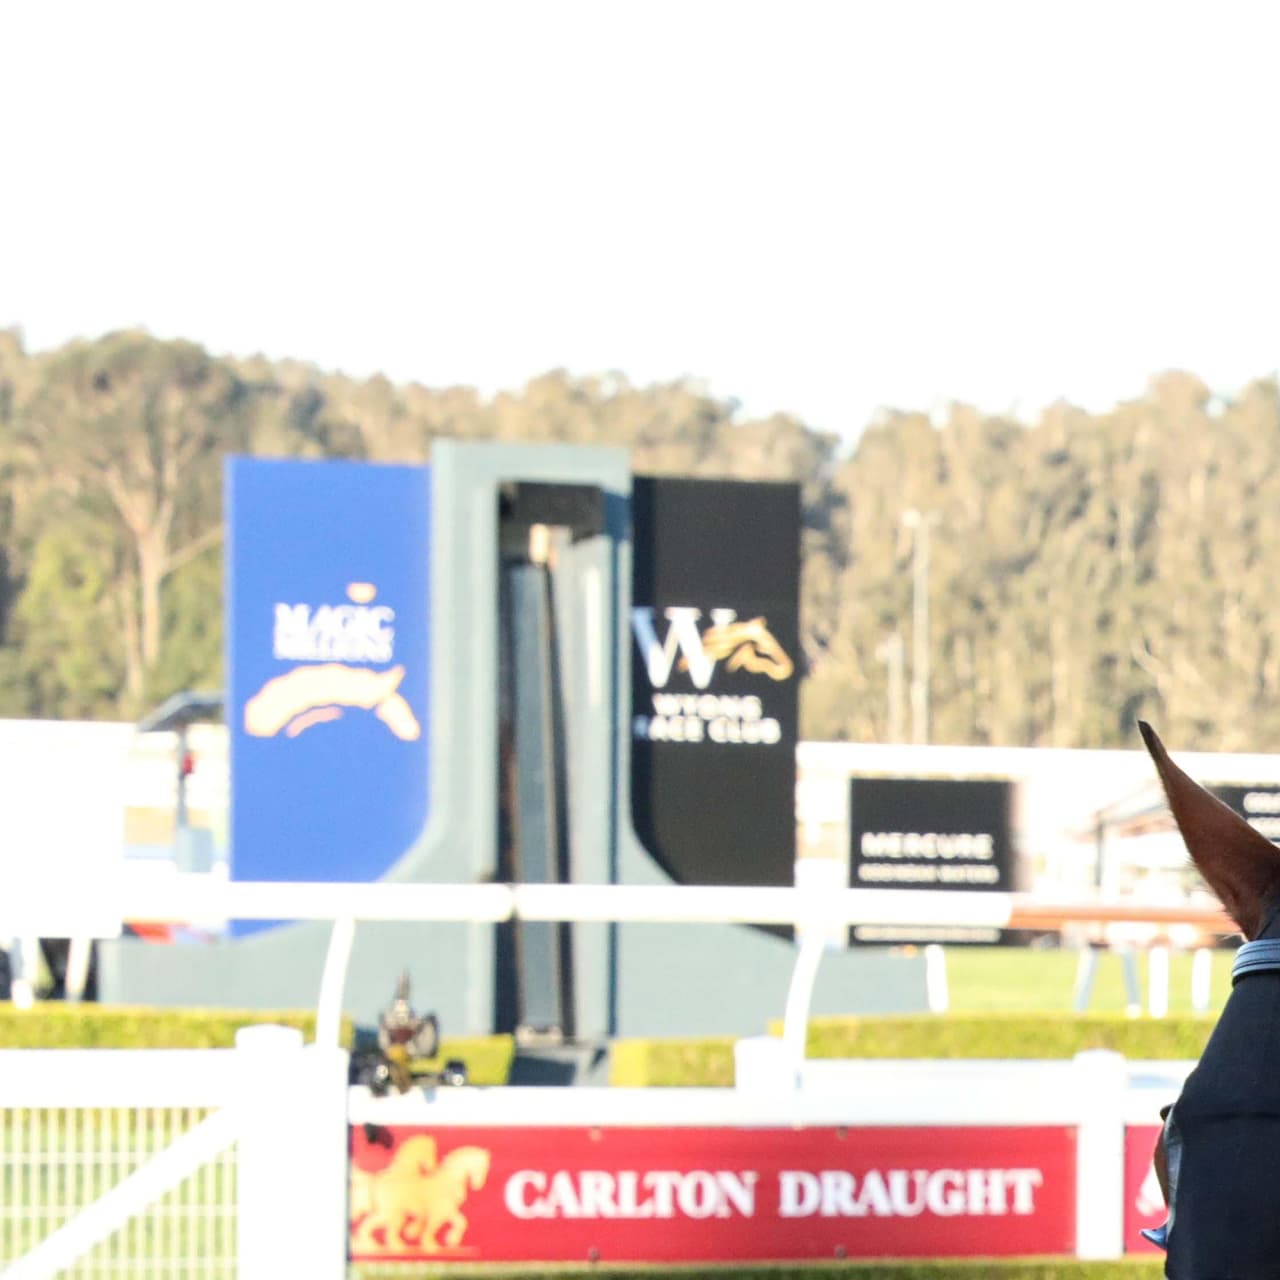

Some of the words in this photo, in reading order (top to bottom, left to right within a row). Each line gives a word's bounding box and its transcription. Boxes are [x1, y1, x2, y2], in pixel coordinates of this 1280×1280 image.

[273, 602, 396, 640] MAGIC
[652, 692, 763, 721] WYONG
[707, 715, 782, 744] CLUB
[503, 1169, 759, 1219] CARLTON
[777, 1167, 1043, 1217] DRAUGHT
